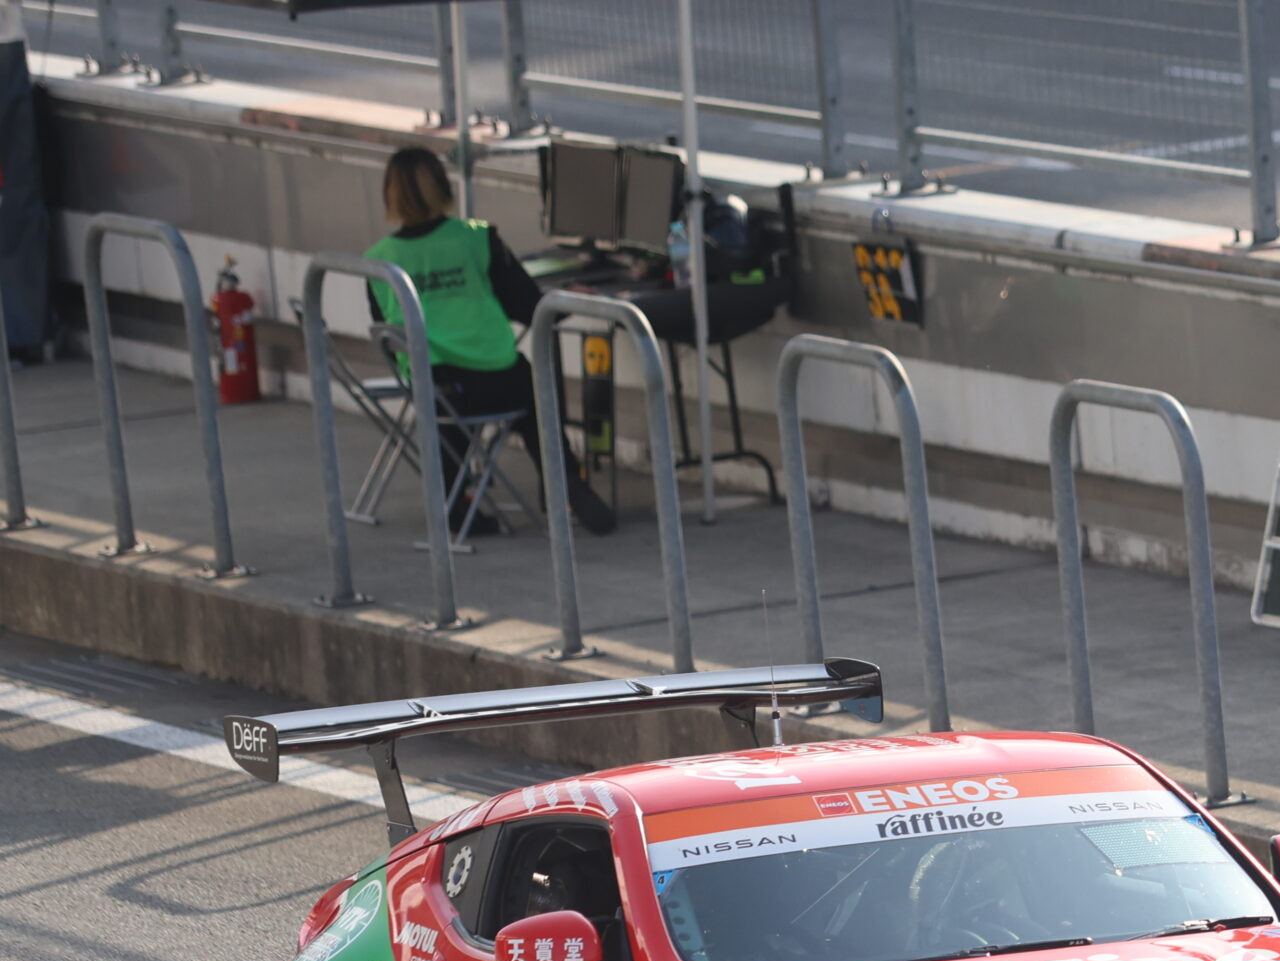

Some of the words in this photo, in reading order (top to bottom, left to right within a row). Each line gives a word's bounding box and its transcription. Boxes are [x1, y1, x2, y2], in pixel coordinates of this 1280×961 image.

[232, 721, 268, 753] Dëff
[820, 801, 850, 809] ENEOS
[854, 777, 1020, 812] ENEOS
[1068, 801, 1164, 814] NISSAN
[876, 806, 1005, 838] raffinée
[682, 833, 797, 859] NISSAN
[395, 921, 439, 954] MOTUL
